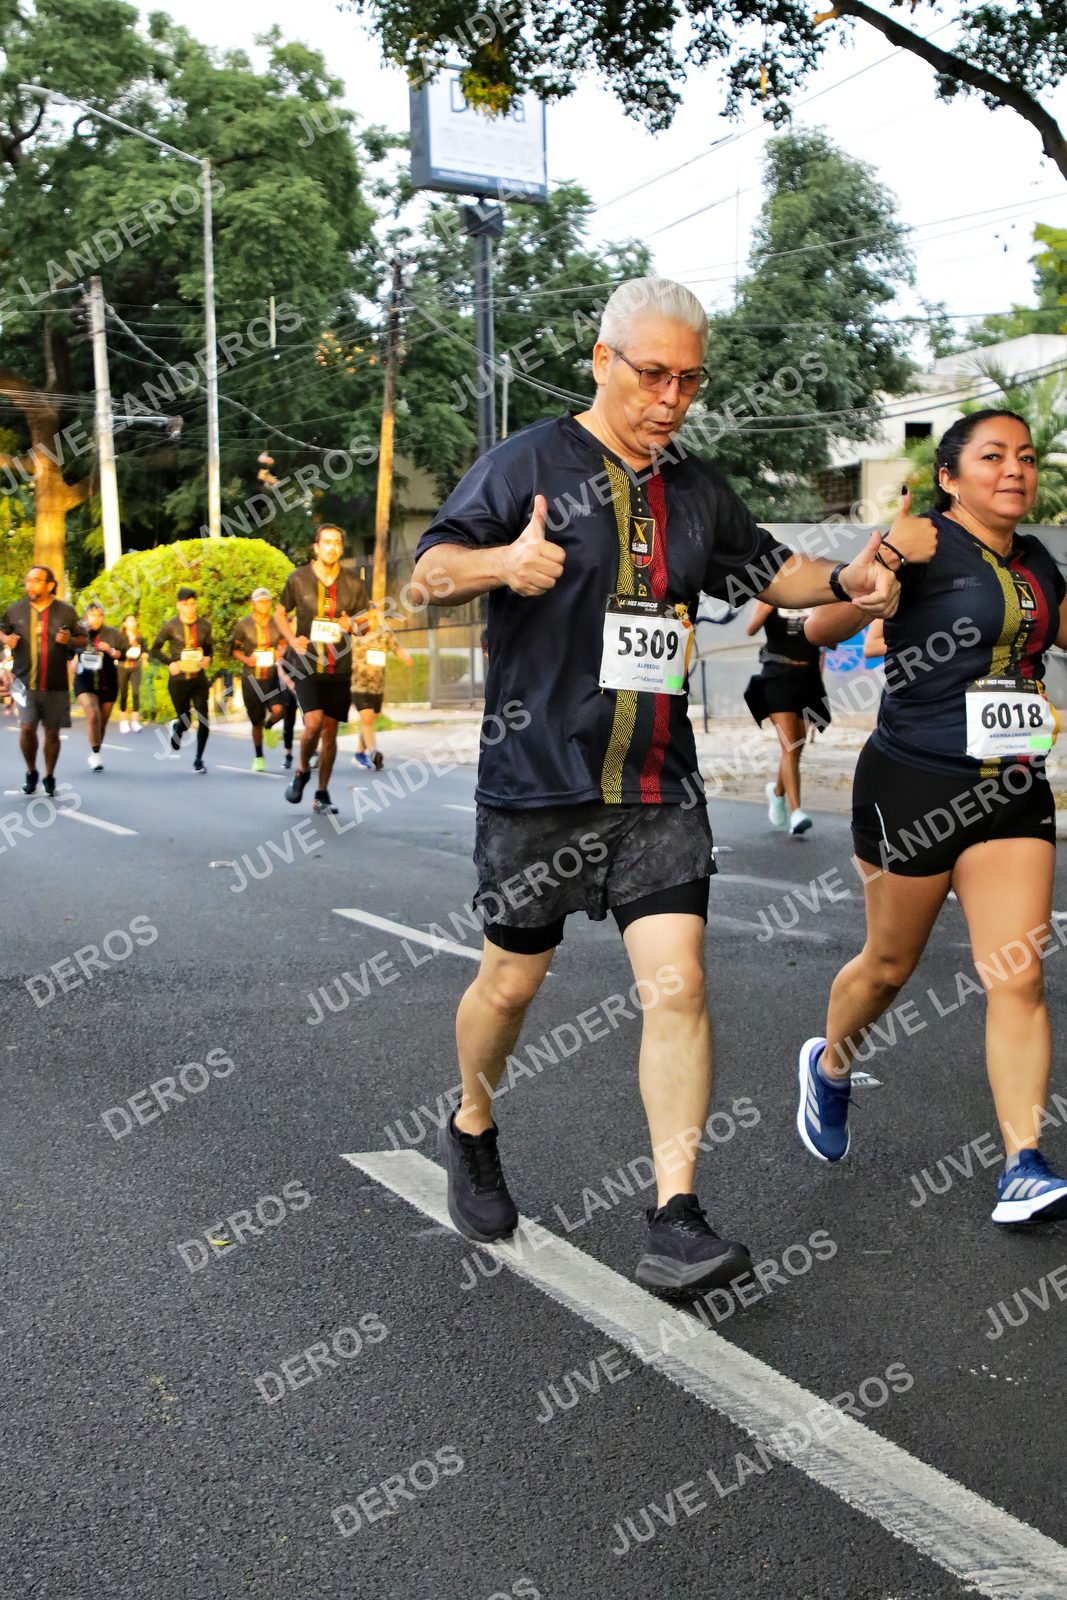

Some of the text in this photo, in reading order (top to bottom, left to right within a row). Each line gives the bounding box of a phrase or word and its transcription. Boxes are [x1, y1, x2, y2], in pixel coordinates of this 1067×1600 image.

[618, 625, 679, 661] 5309
[637, 662, 660, 670] ALFREDO
[981, 702, 1043, 729] 6018
